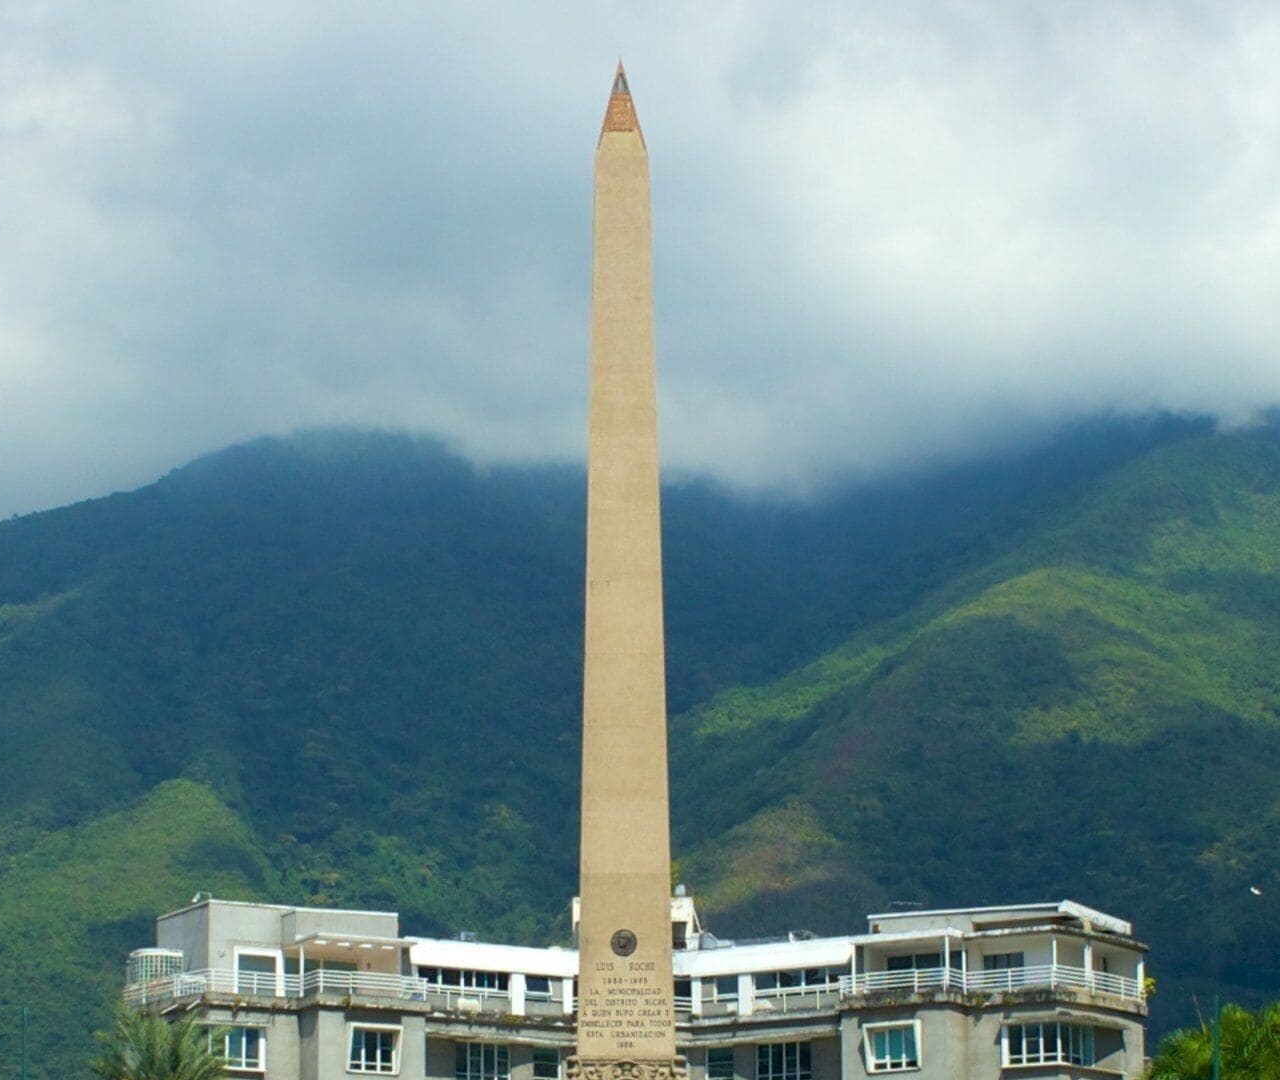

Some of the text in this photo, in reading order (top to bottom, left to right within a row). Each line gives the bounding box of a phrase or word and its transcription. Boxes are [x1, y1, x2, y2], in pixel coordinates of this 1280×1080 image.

[595, 962, 656, 972] LUIS ROCHE
[589, 988, 662, 996] LA MUNICIPALIDAD
[584, 999, 598, 1007] DEL
[605, 999, 638, 1007] DISTRITO
[591, 1009, 612, 1017] QUIEN
[615, 1009, 634, 1017] SUPO
[637, 1009, 661, 1017] CREAR
[580, 1020, 672, 1028] EMBELLECER PARA TODOS
[586, 1031, 604, 1039] ESTA
